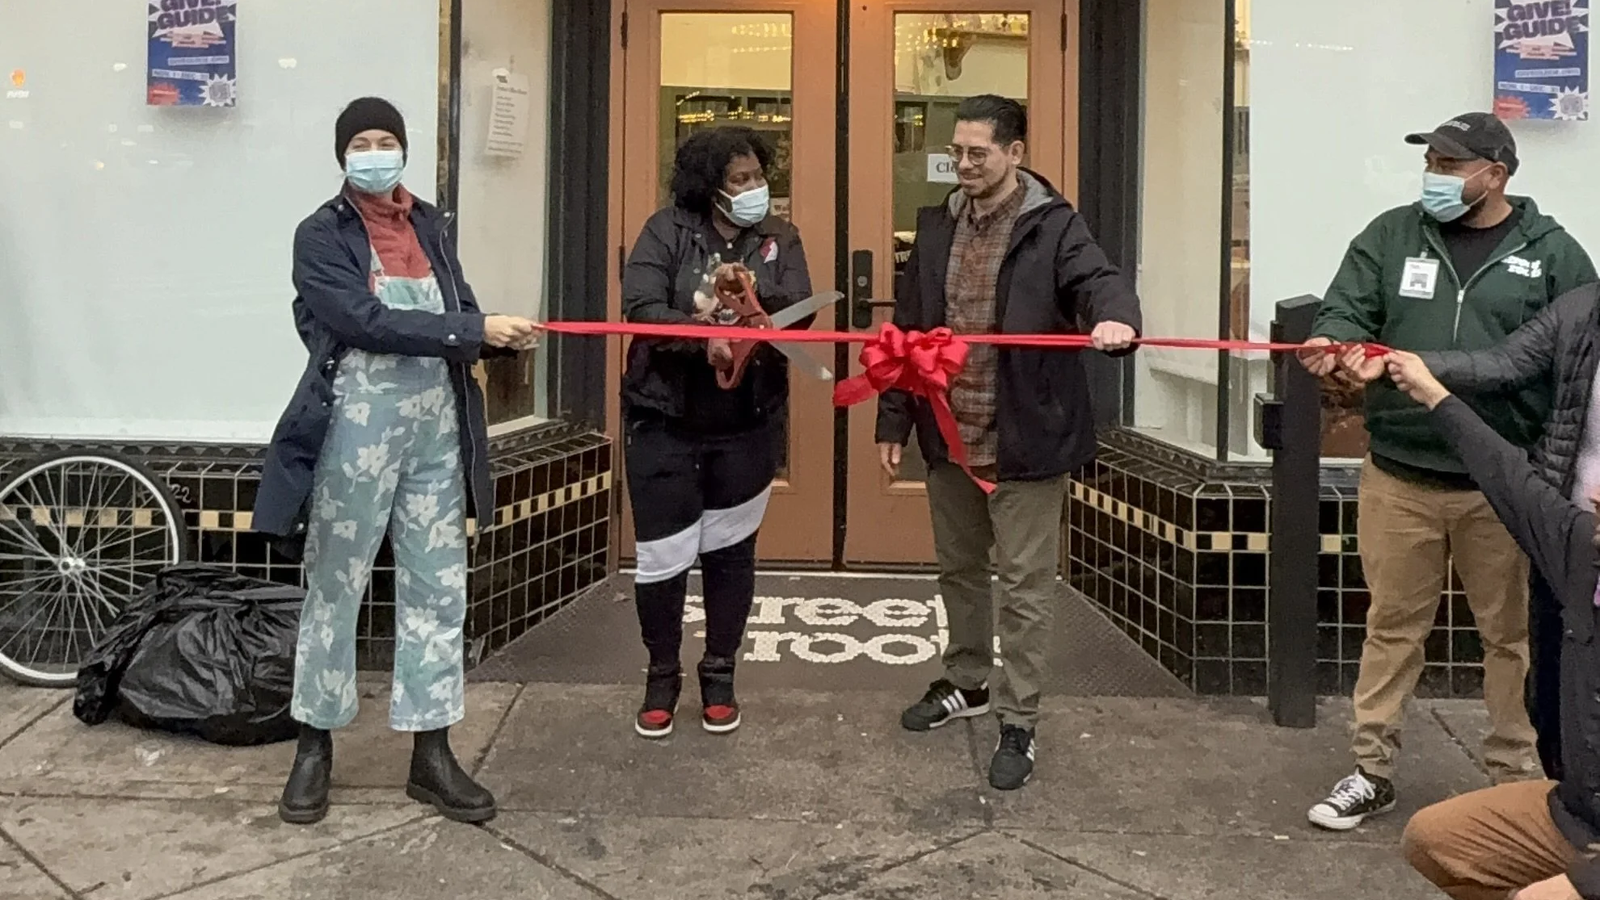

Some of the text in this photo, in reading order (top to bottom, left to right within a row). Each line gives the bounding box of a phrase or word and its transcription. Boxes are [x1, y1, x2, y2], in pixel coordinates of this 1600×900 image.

[157, 6, 230, 30] GUIDE
[1507, 0, 1572, 22] GIVE!
[1503, 16, 1580, 40] GUIDE
[682, 593, 949, 627] ree
